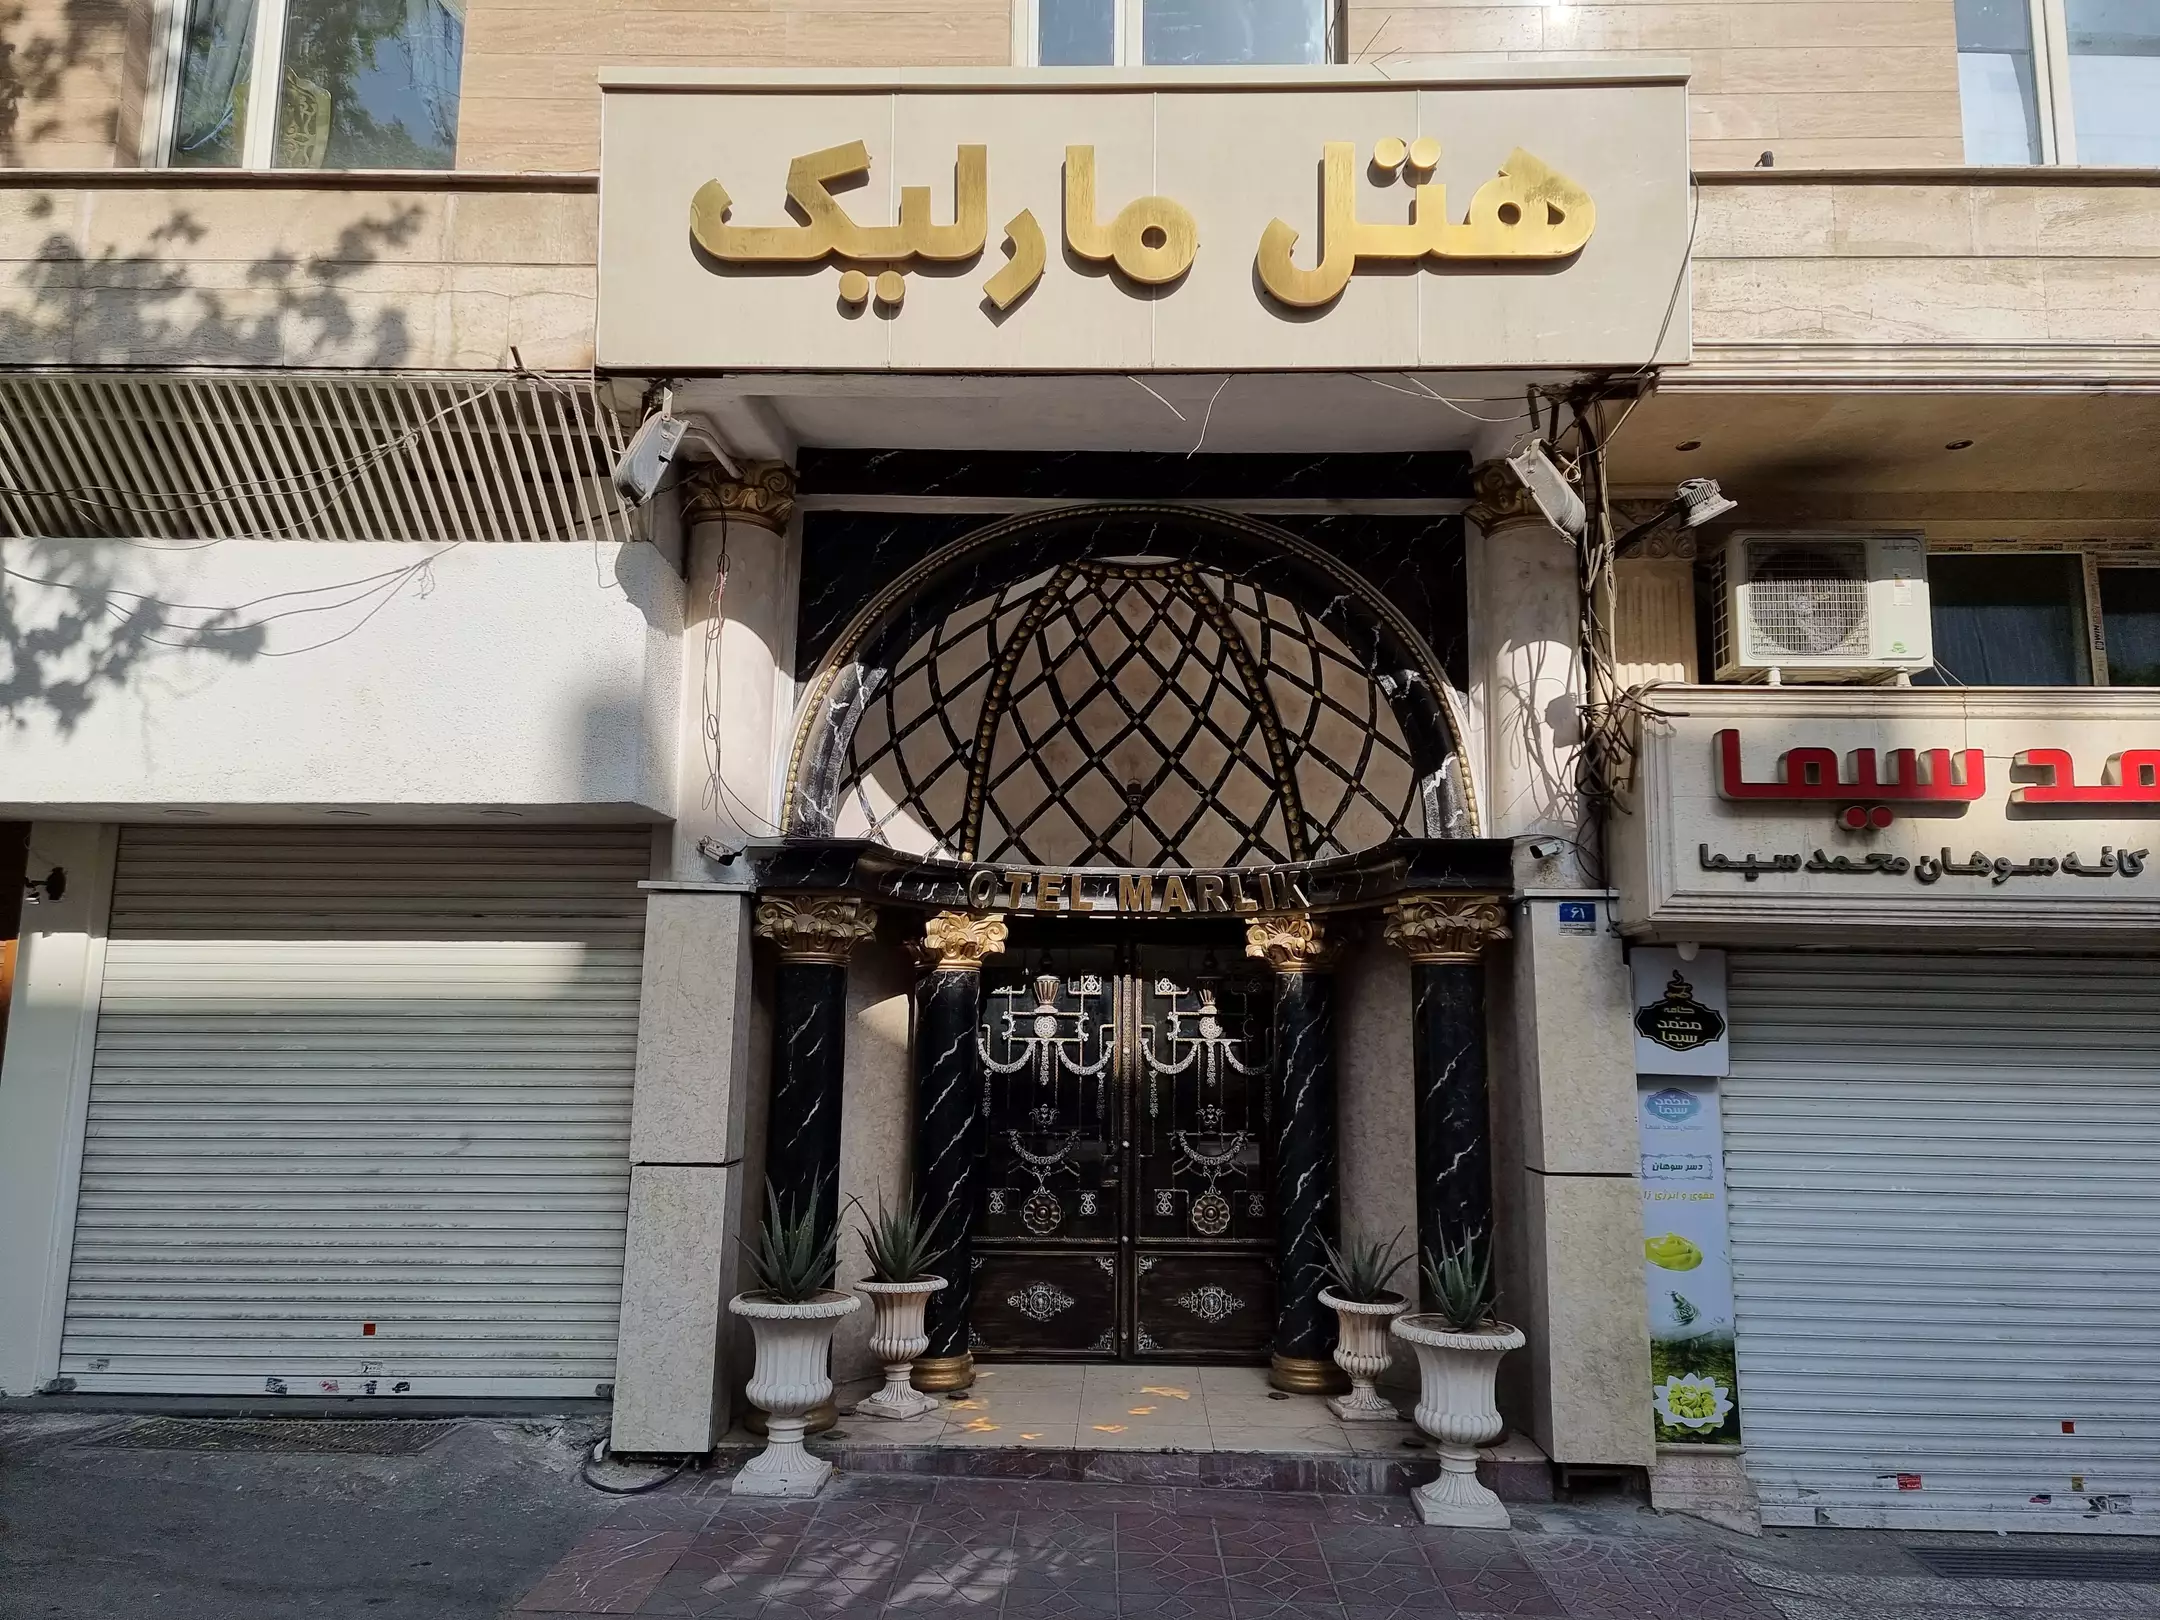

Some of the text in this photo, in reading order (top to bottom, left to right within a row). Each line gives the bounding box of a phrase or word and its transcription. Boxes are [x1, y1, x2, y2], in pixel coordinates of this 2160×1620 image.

[689, 135, 1597, 312] هتل مارلیک
[1713, 727, 2160, 831] مد سیما
[1699, 843, 2151, 887] کافه سوهان محمد سیما
[968, 869, 1313, 913] OTEL MARLIK
[1663, 1005, 1696, 1015] کافه
[1661, 1030, 1699, 1047] سیما
[1658, 1105, 1688, 1118] سیما
[1652, 1162, 1704, 1172] دسر سوهان
